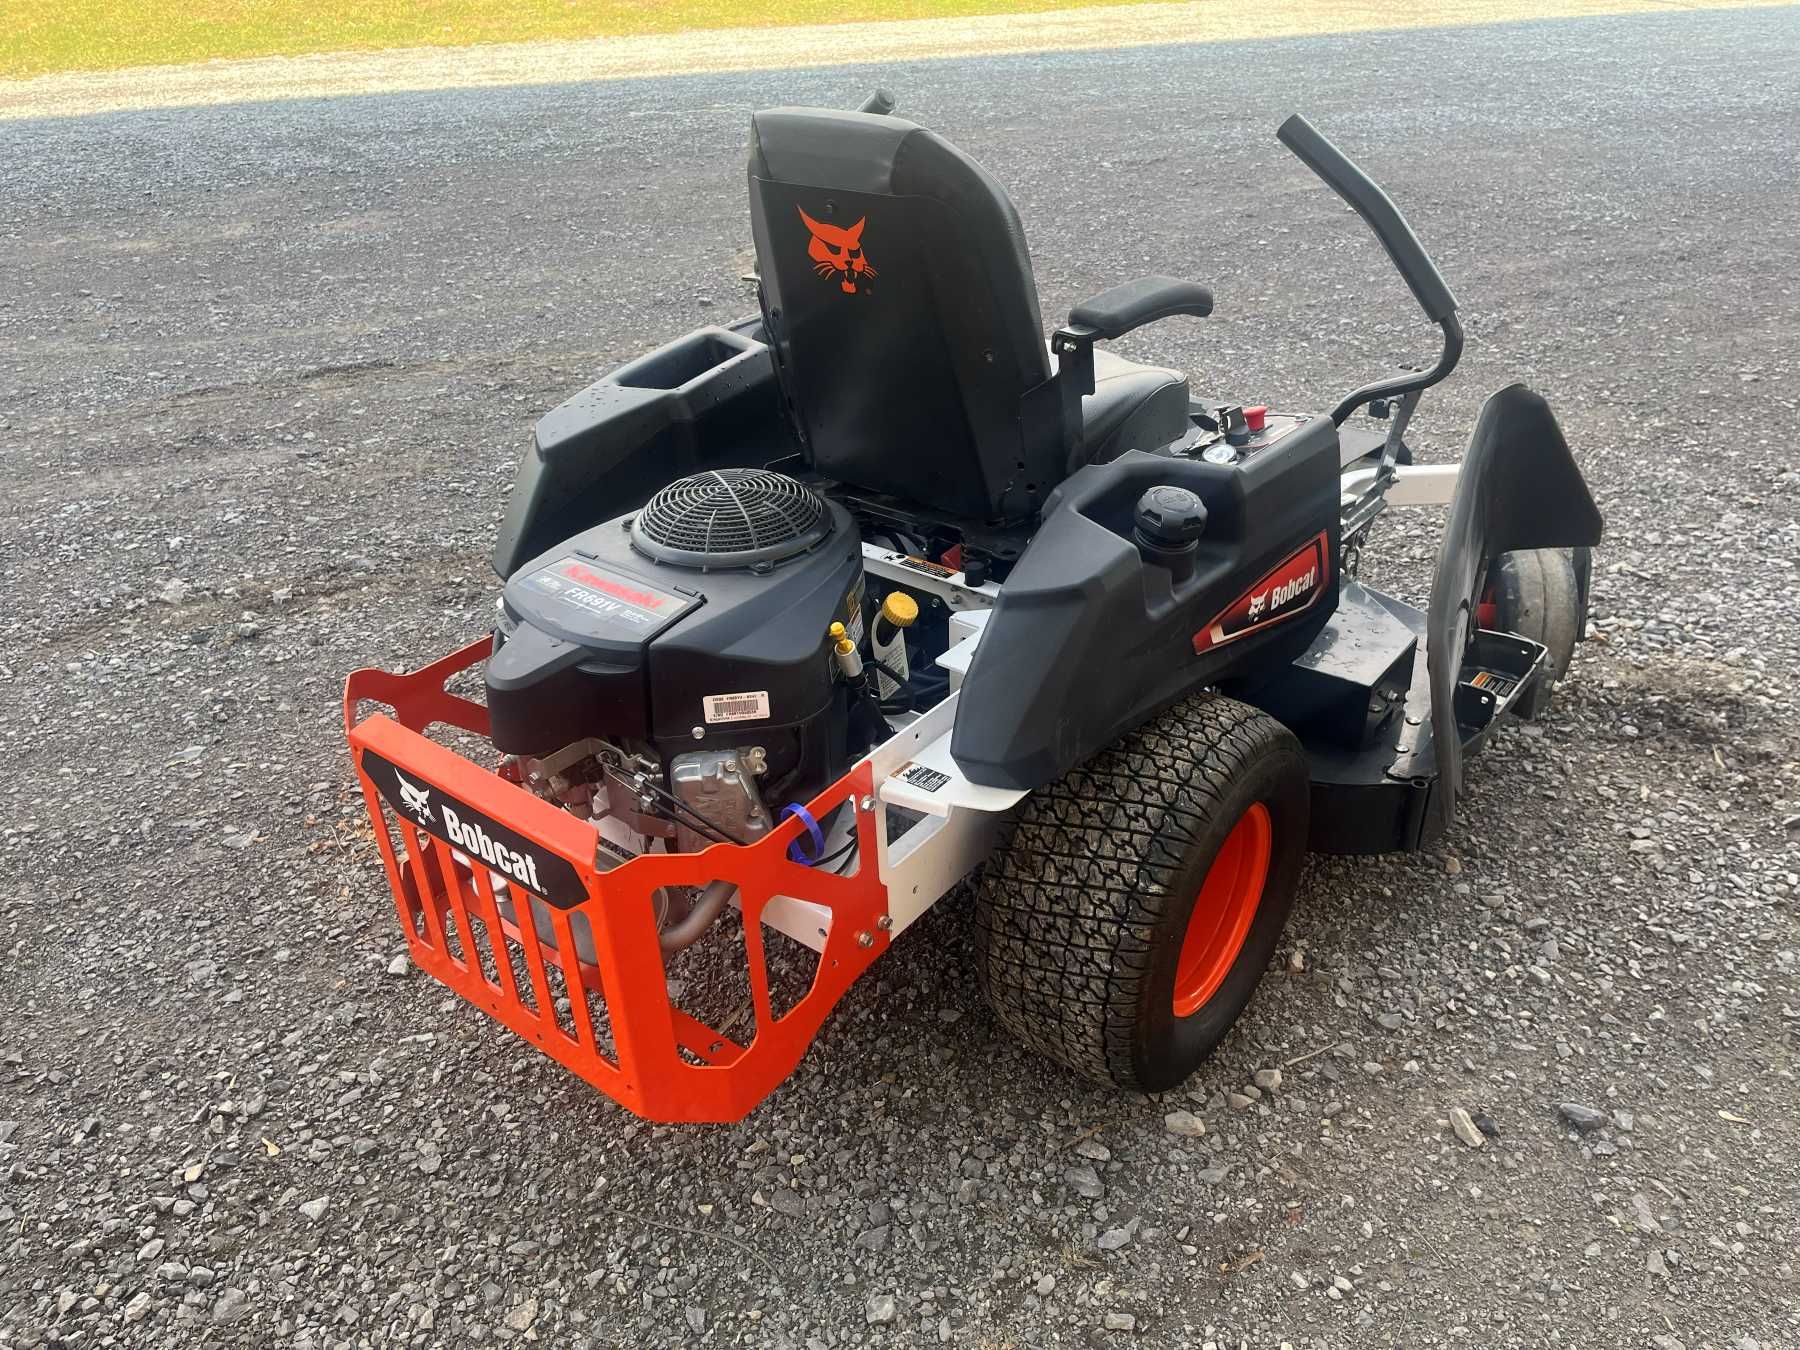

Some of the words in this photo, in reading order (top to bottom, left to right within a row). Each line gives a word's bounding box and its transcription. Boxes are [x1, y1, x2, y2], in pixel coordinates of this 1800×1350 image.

[562, 564, 664, 609] Kawasaki
[564, 587, 621, 611] FR691V
[1271, 566, 1315, 610] Bobcat
[441, 805, 541, 892] Bobcat
